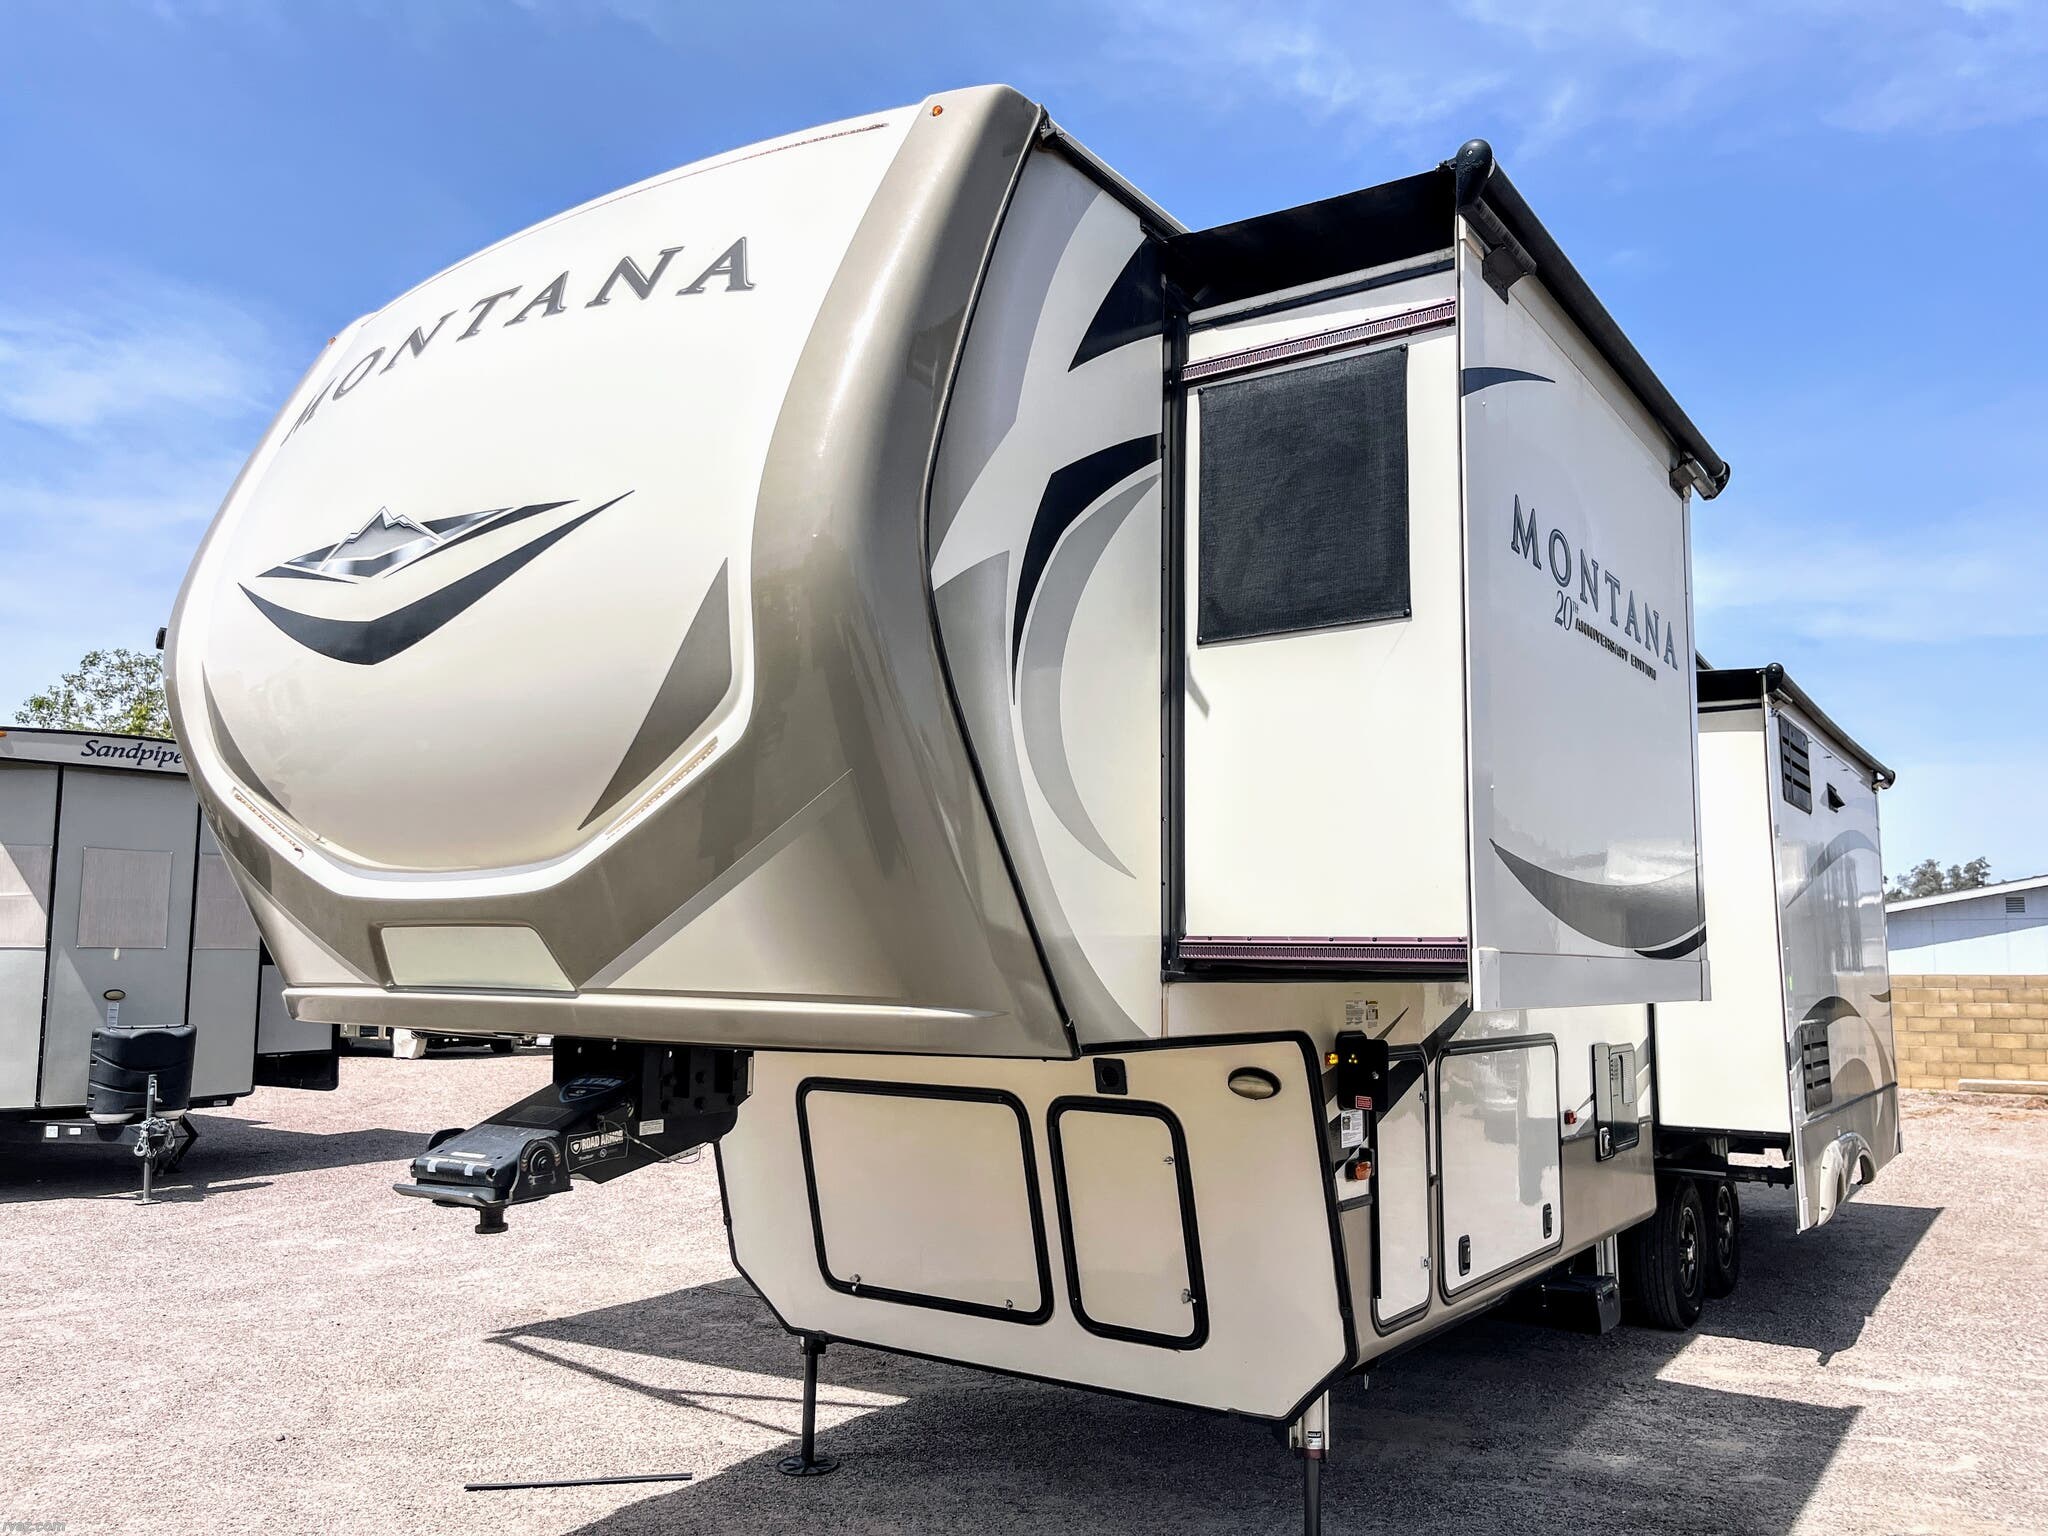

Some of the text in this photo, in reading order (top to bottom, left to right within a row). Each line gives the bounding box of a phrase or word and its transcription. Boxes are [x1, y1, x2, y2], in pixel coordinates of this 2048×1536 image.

[280, 236, 757, 447] MONTANA
[1511, 494, 1678, 670] MONTANA
[1575, 617, 1629, 662] ANNIVERSARY
[1630, 653, 1657, 681] EDITION
[80, 740, 183, 767] Sandpipe
[582, 1136, 600, 1150] ROAD
[601, 1130, 624, 1145] ARMOR
